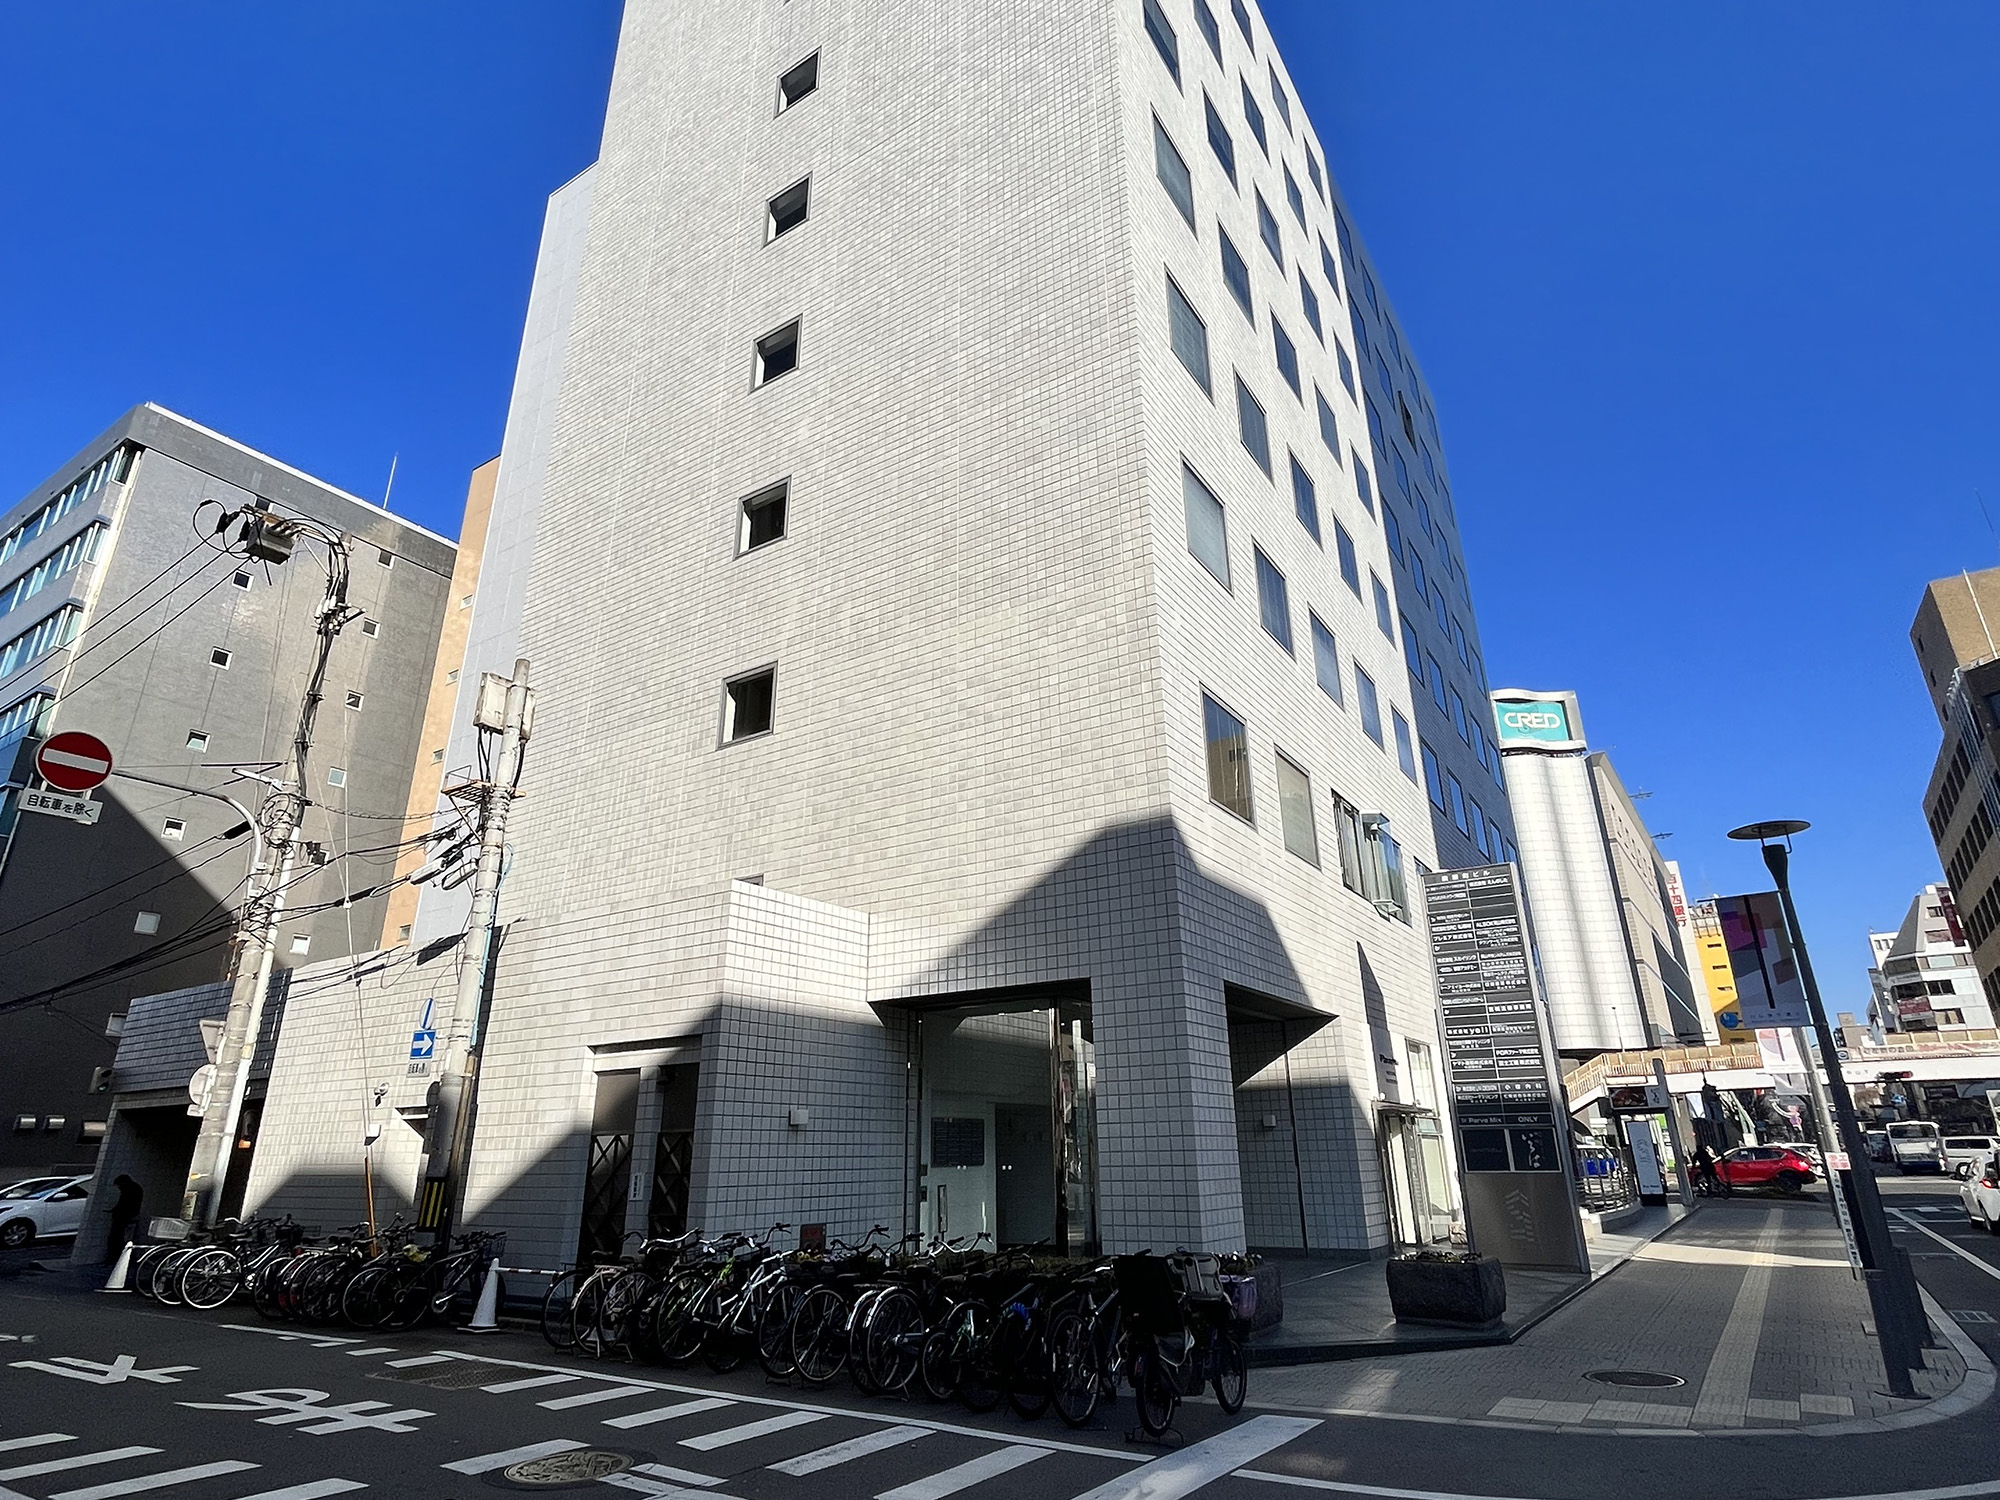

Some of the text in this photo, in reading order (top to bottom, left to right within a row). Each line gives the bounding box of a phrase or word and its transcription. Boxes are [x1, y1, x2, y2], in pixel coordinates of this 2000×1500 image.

[1504, 712, 1561, 729] CRED
[27, 794, 94, 818] 自転車を除く
